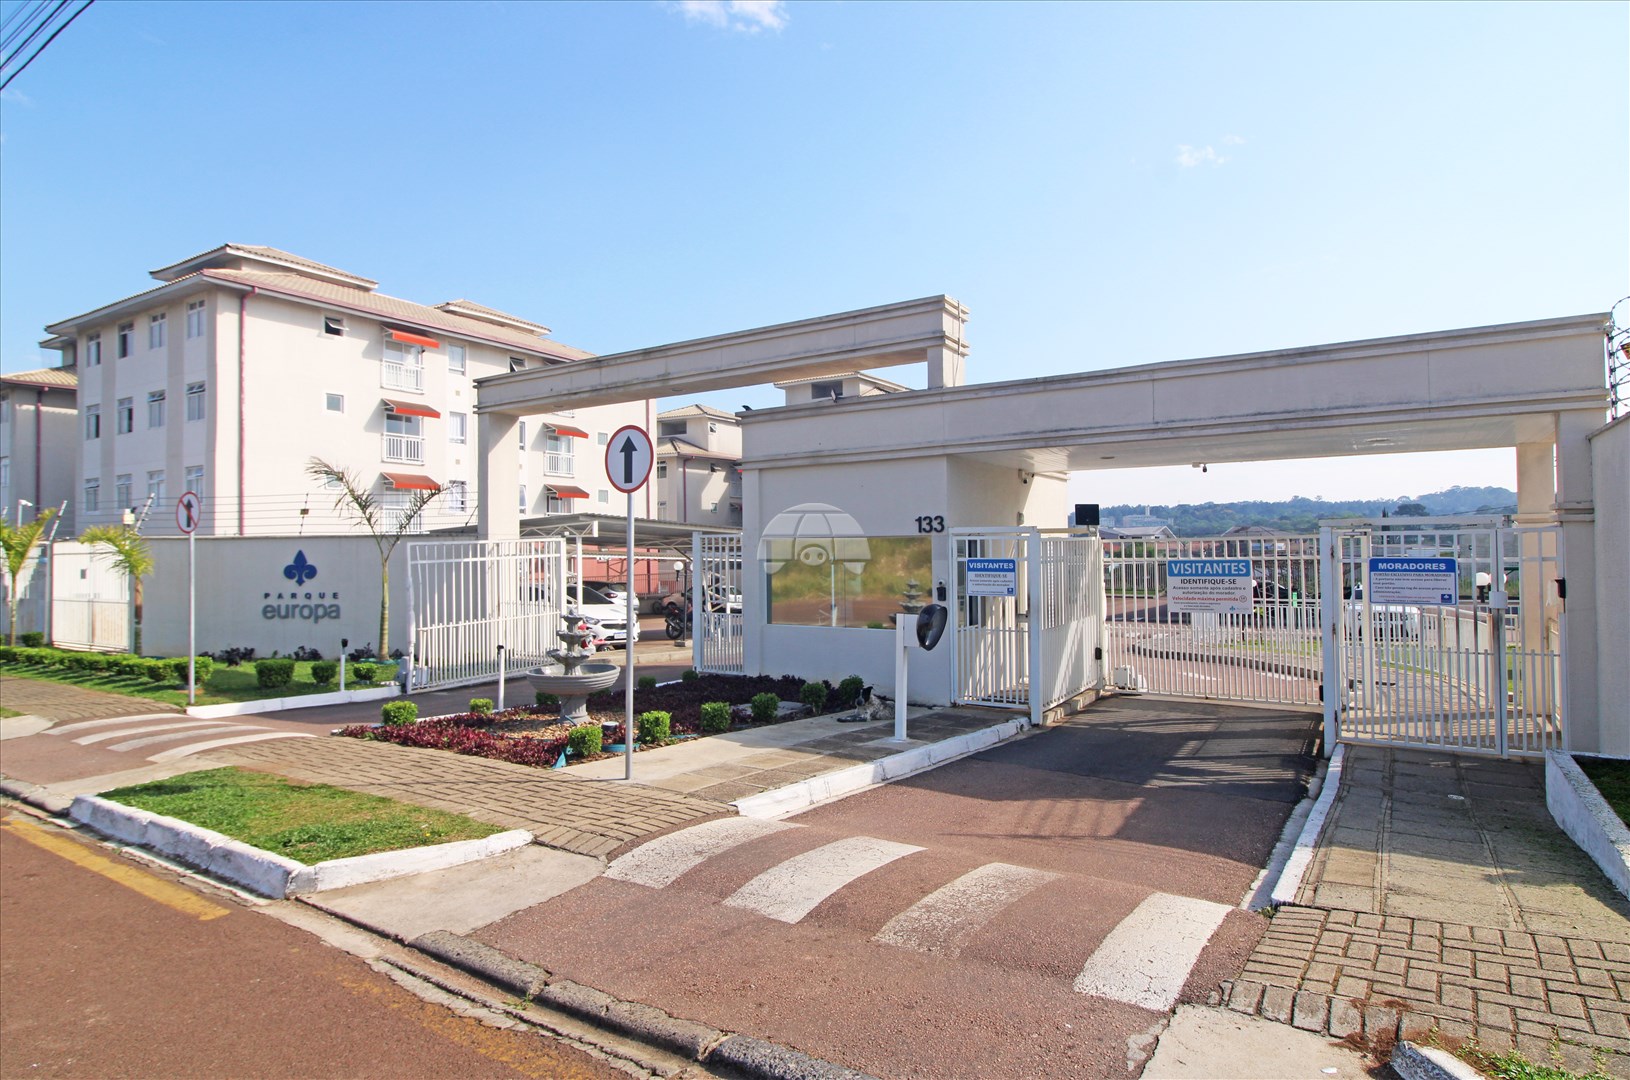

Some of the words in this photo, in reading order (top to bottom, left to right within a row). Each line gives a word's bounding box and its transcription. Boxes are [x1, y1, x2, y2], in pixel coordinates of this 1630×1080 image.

[915, 515, 945, 533] 133
[1172, 563, 1246, 574] VISITANTES
[262, 604, 340, 624] europa
